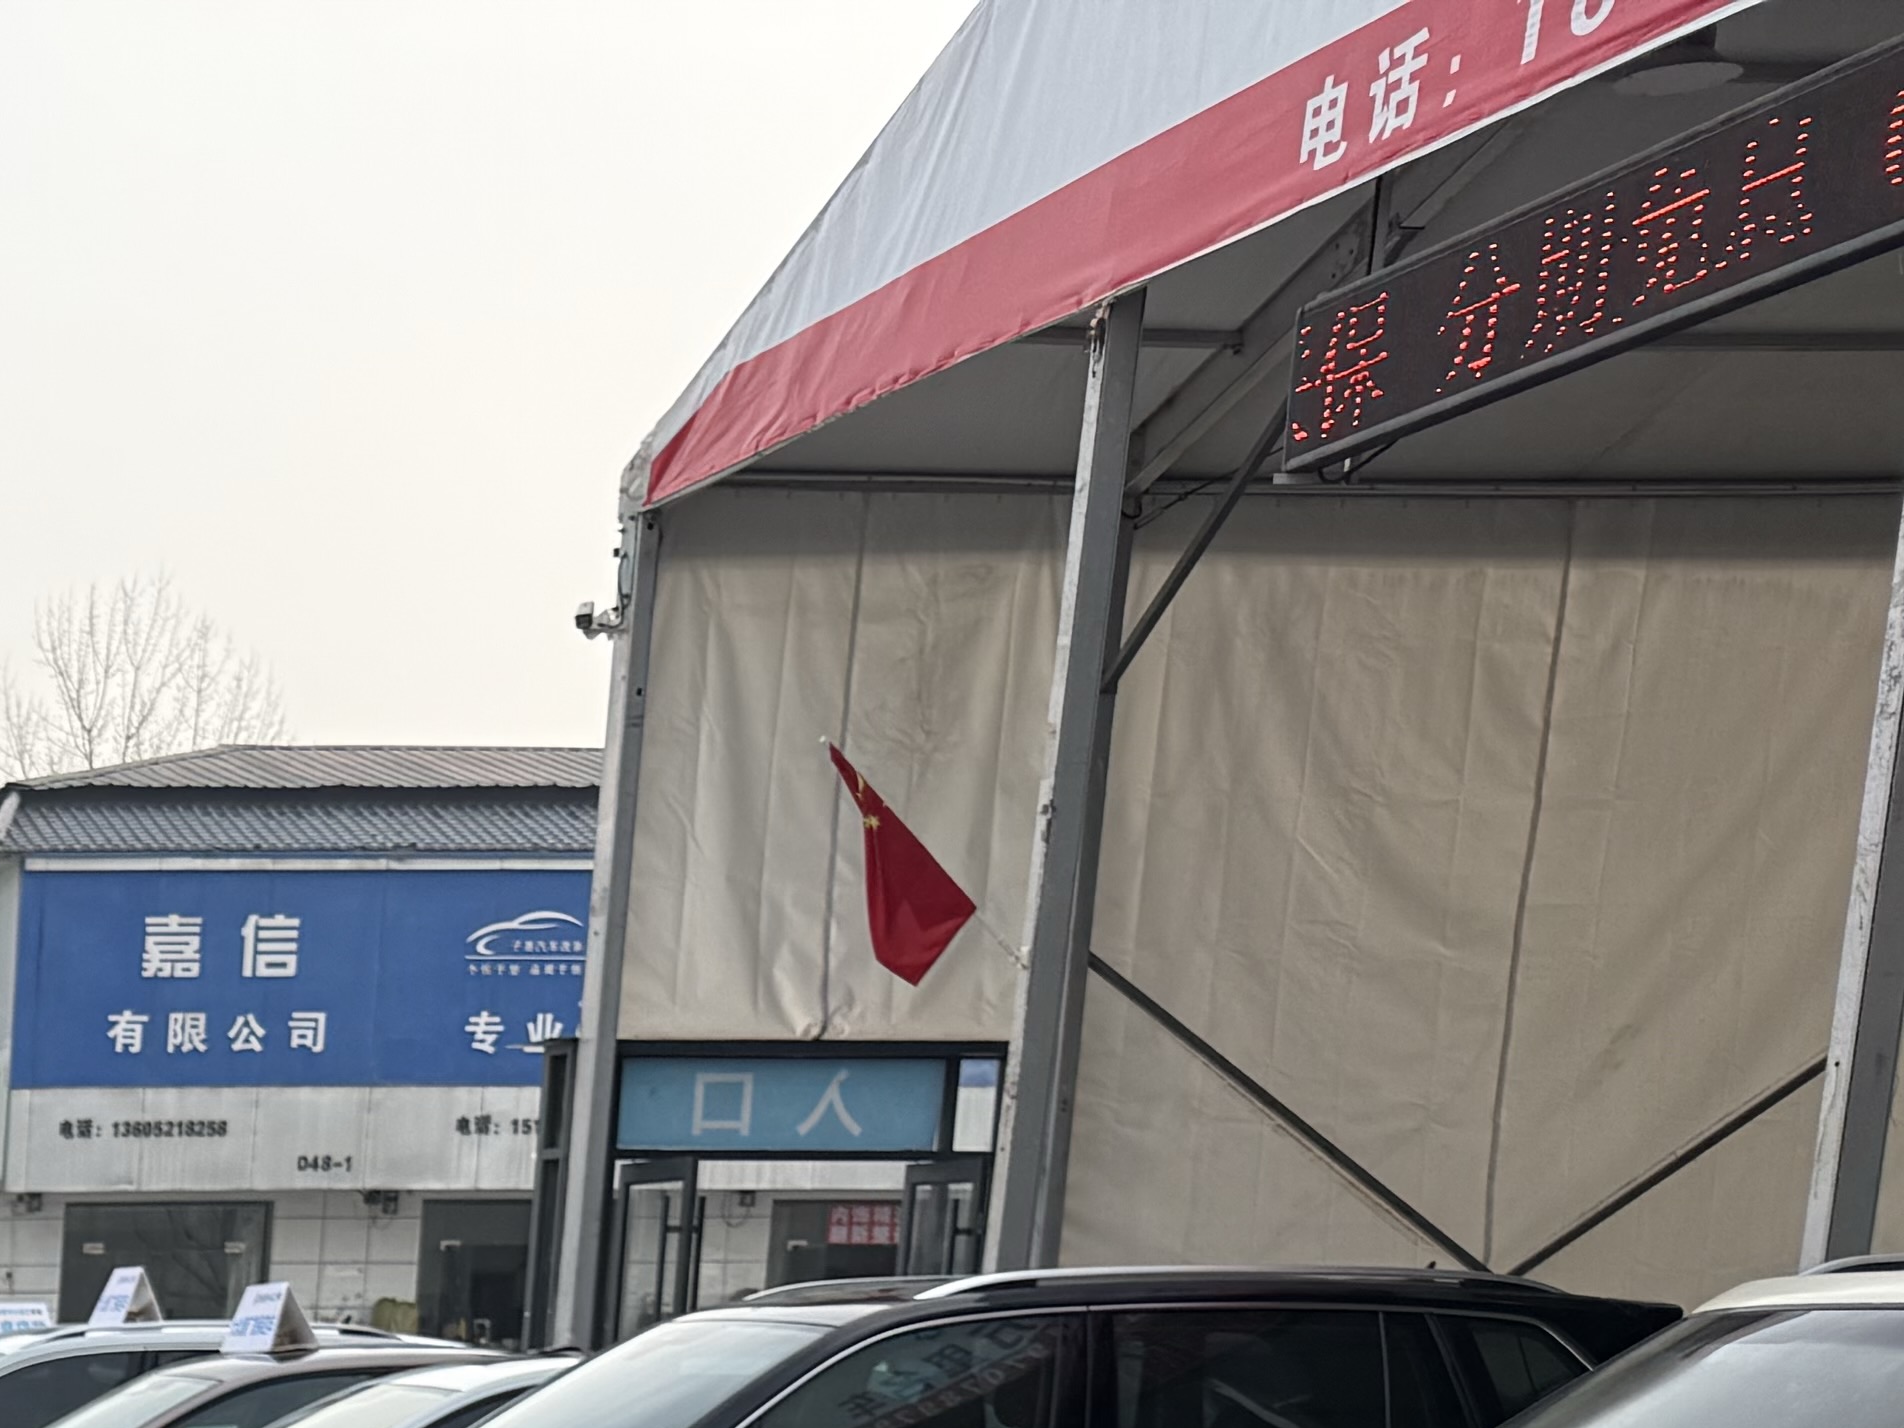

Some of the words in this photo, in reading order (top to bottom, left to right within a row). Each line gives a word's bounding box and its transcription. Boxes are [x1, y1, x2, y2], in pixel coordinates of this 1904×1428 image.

[141, 915, 301, 978] 嘉信
[106, 1010, 327, 1054] 有限公司
[464, 1010, 583, 1055] 专业
